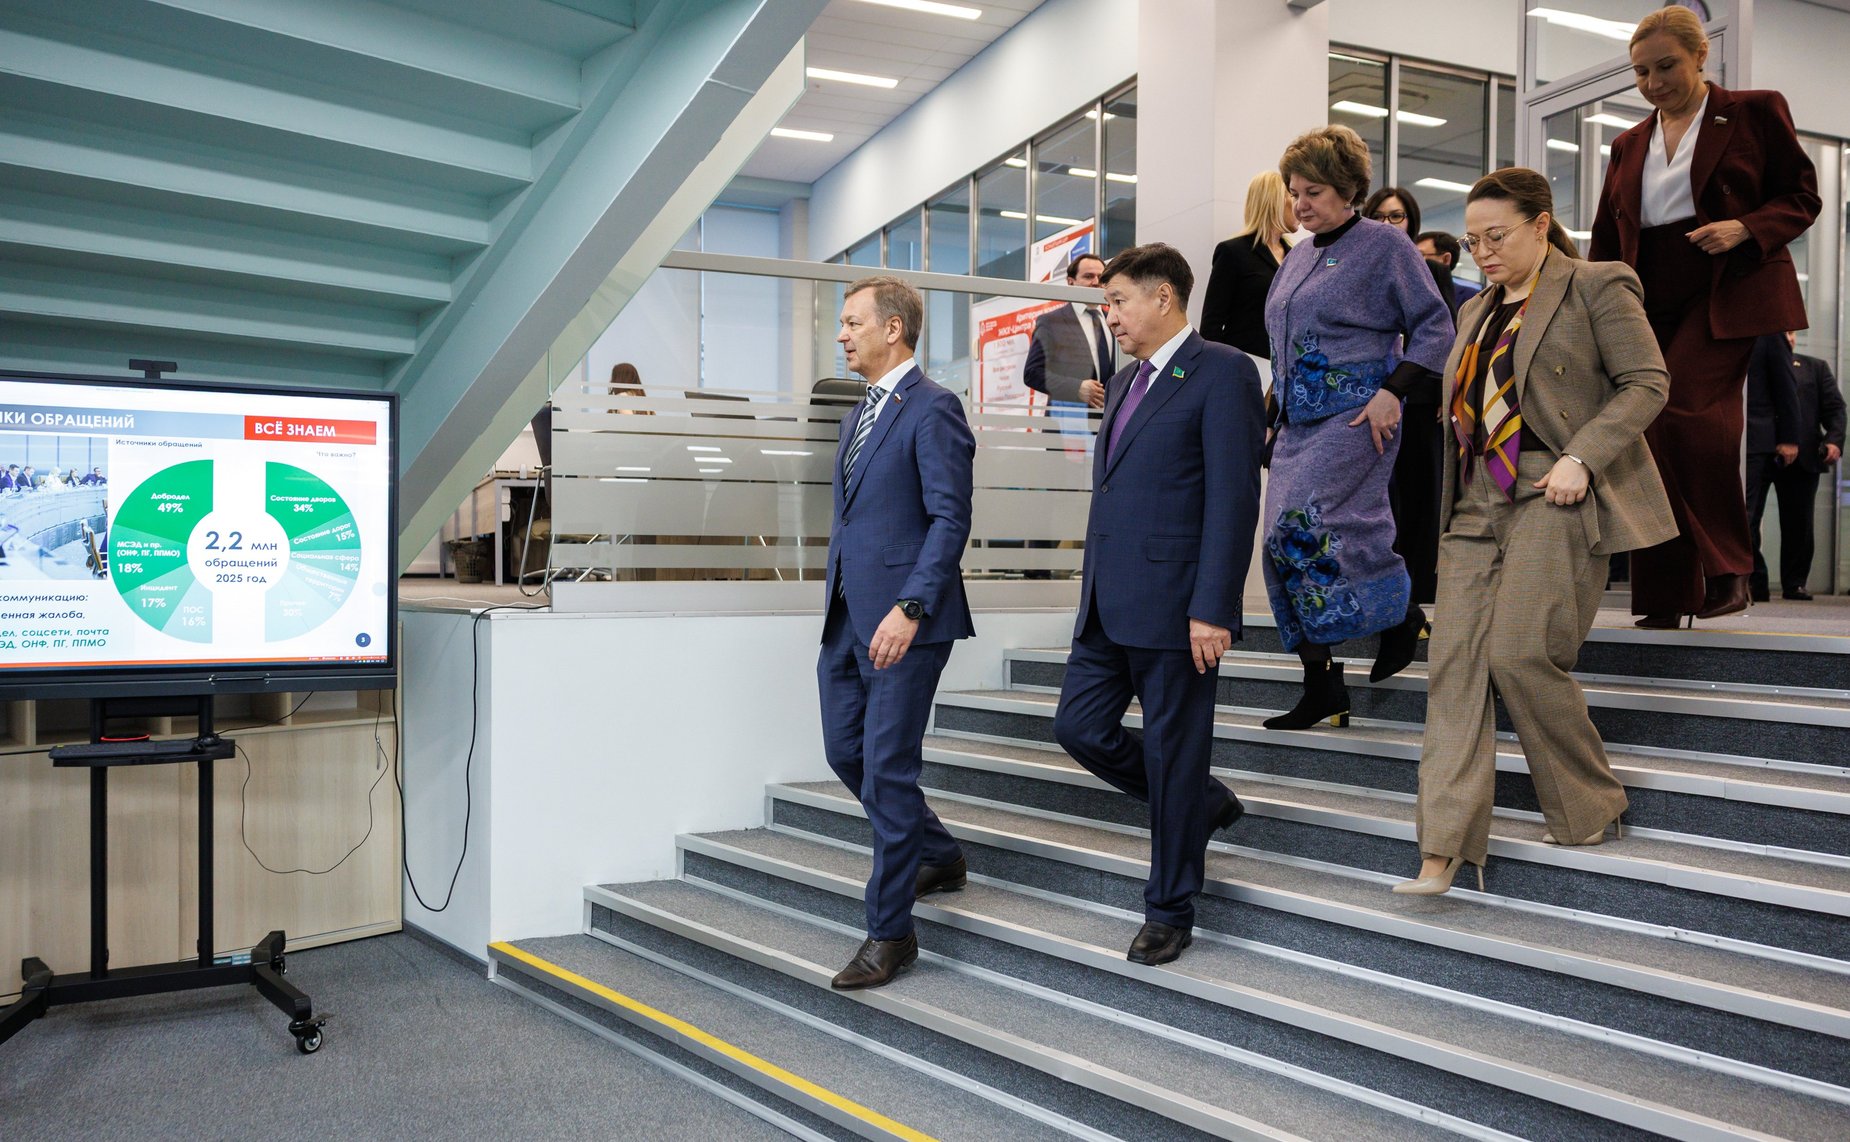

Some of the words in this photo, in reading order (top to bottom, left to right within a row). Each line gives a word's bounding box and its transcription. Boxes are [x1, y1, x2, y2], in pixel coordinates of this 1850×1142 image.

[30, 412, 135, 429] ОБРАЩЕНИЙ
[254, 420, 283, 435] ВСЁ
[286, 423, 336, 437] ЗНАЕМ
[150, 492, 191, 501] Добродел
[157, 502, 184, 514] 49%
[293, 504, 314, 513] 34%
[335, 529, 356, 542] 15%
[205, 530, 243, 553] 2,2
[250, 542, 278, 551] млн
[117, 563, 144, 574] 18%
[204, 557, 278, 569] обращений
[340, 562, 359, 572] 14%
[216, 573, 243, 583] 2025
[246, 575, 267, 584] год
[141, 598, 167, 608] 17%
[182, 616, 206, 626] 16%
[22, 629, 73, 637] соцсети,
[72, 638, 106, 648] ППМО
